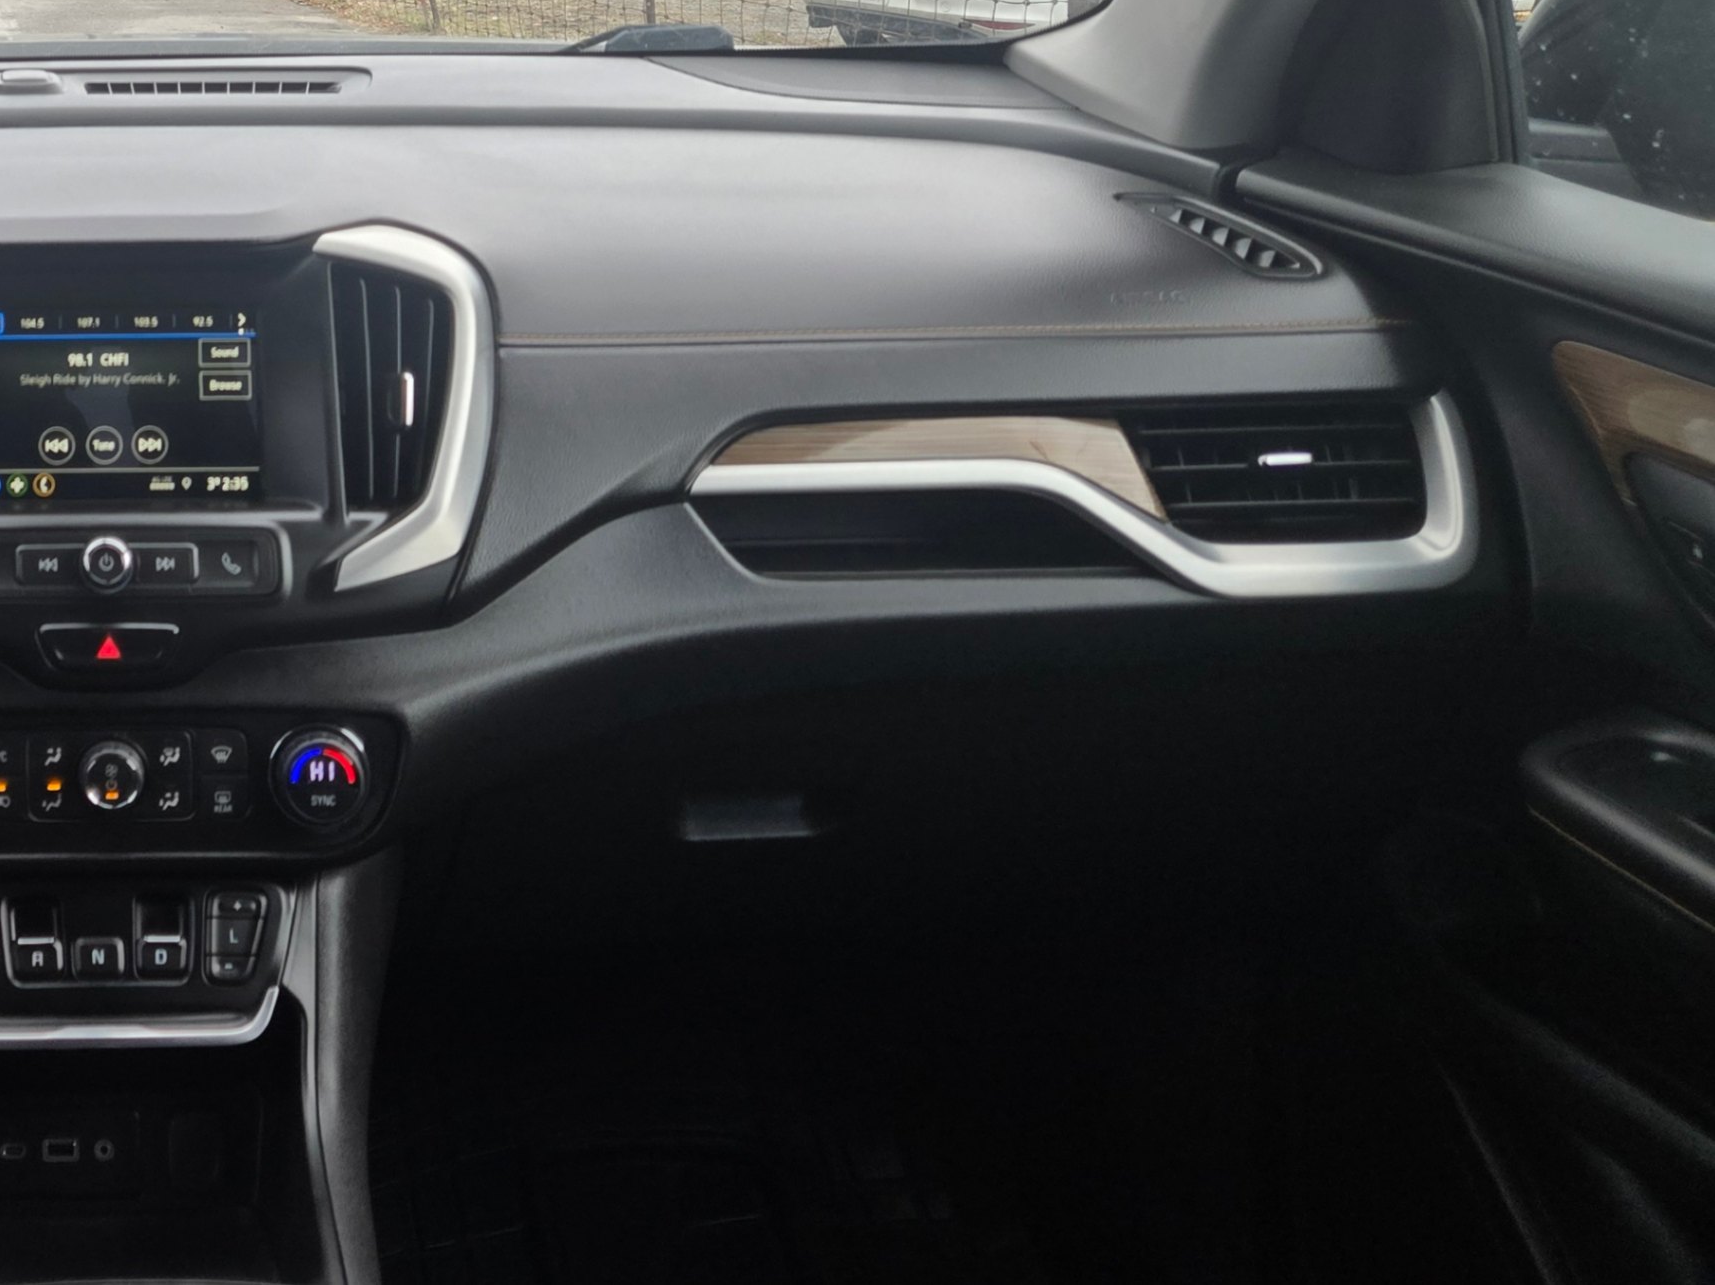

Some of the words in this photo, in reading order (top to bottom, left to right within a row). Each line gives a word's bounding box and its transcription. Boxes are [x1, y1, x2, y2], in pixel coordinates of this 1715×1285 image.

[67, 352, 93, 367] 98.1
[100, 352, 129, 367] CHFI
[210, 346, 240, 359] Sound
[19, 374, 52, 389] Sleigh
[53, 374, 76, 386] Ride
[78, 374, 92, 389] by
[93, 373, 121, 388] Harry
[209, 379, 242, 392] Browse
[92, 439, 116, 452] Tune
[310, 761, 335, 782] HI
[214, 804, 233, 813] REAR
[311, 795, 336, 807] SYNC
[229, 927, 237, 944] L
[92, 949, 105, 965] N
[154, 949, 168, 965] D
